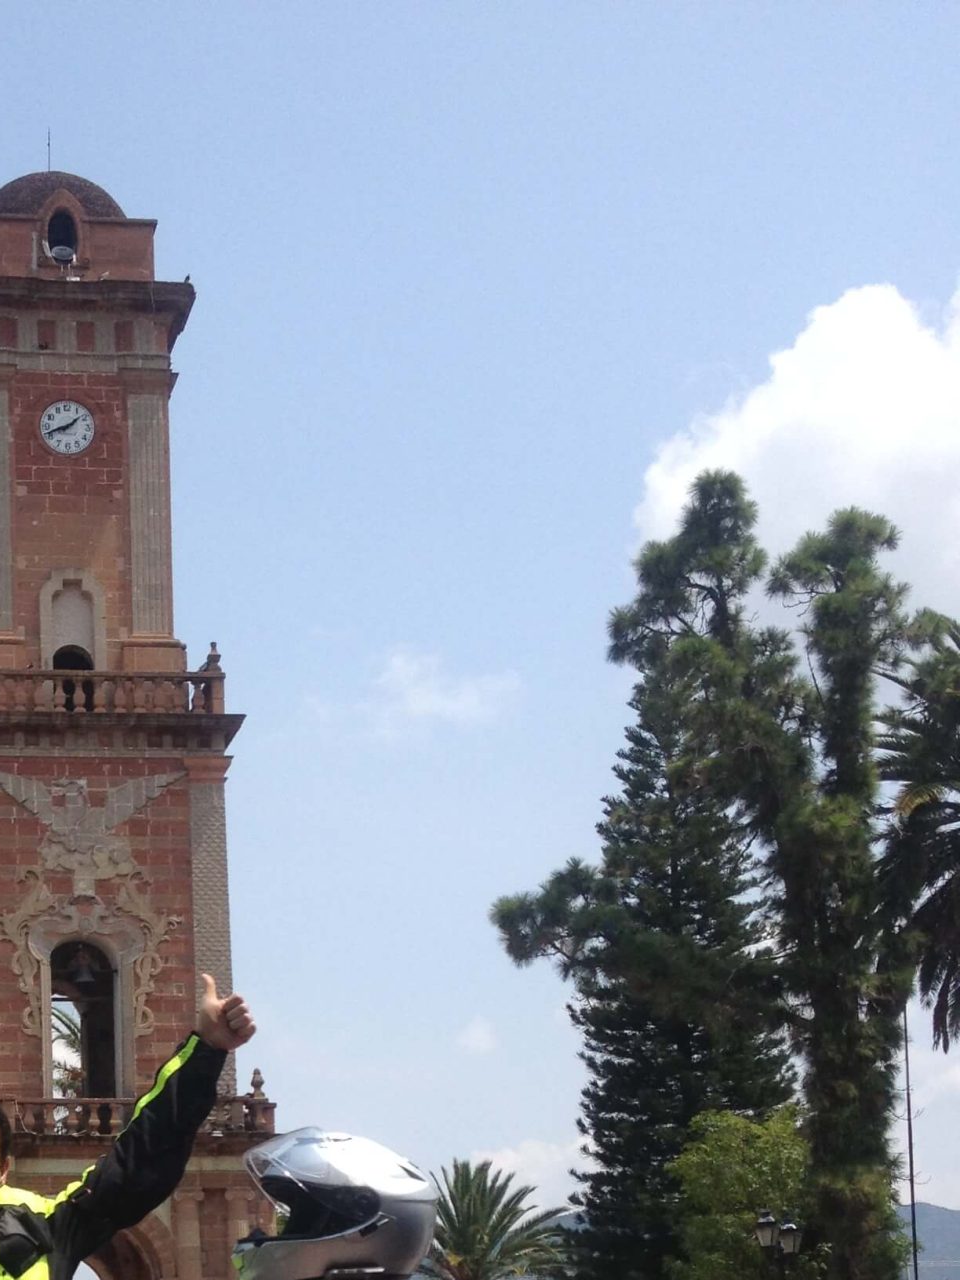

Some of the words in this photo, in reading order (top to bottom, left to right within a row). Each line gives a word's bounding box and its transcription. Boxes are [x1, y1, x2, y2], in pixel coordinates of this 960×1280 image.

[47, 413, 55, 421] 10
[85, 424, 91, 432] 3
[56, 439, 62, 447] 7
[65, 442, 71, 450] 6
[74, 440, 81, 448] 5
